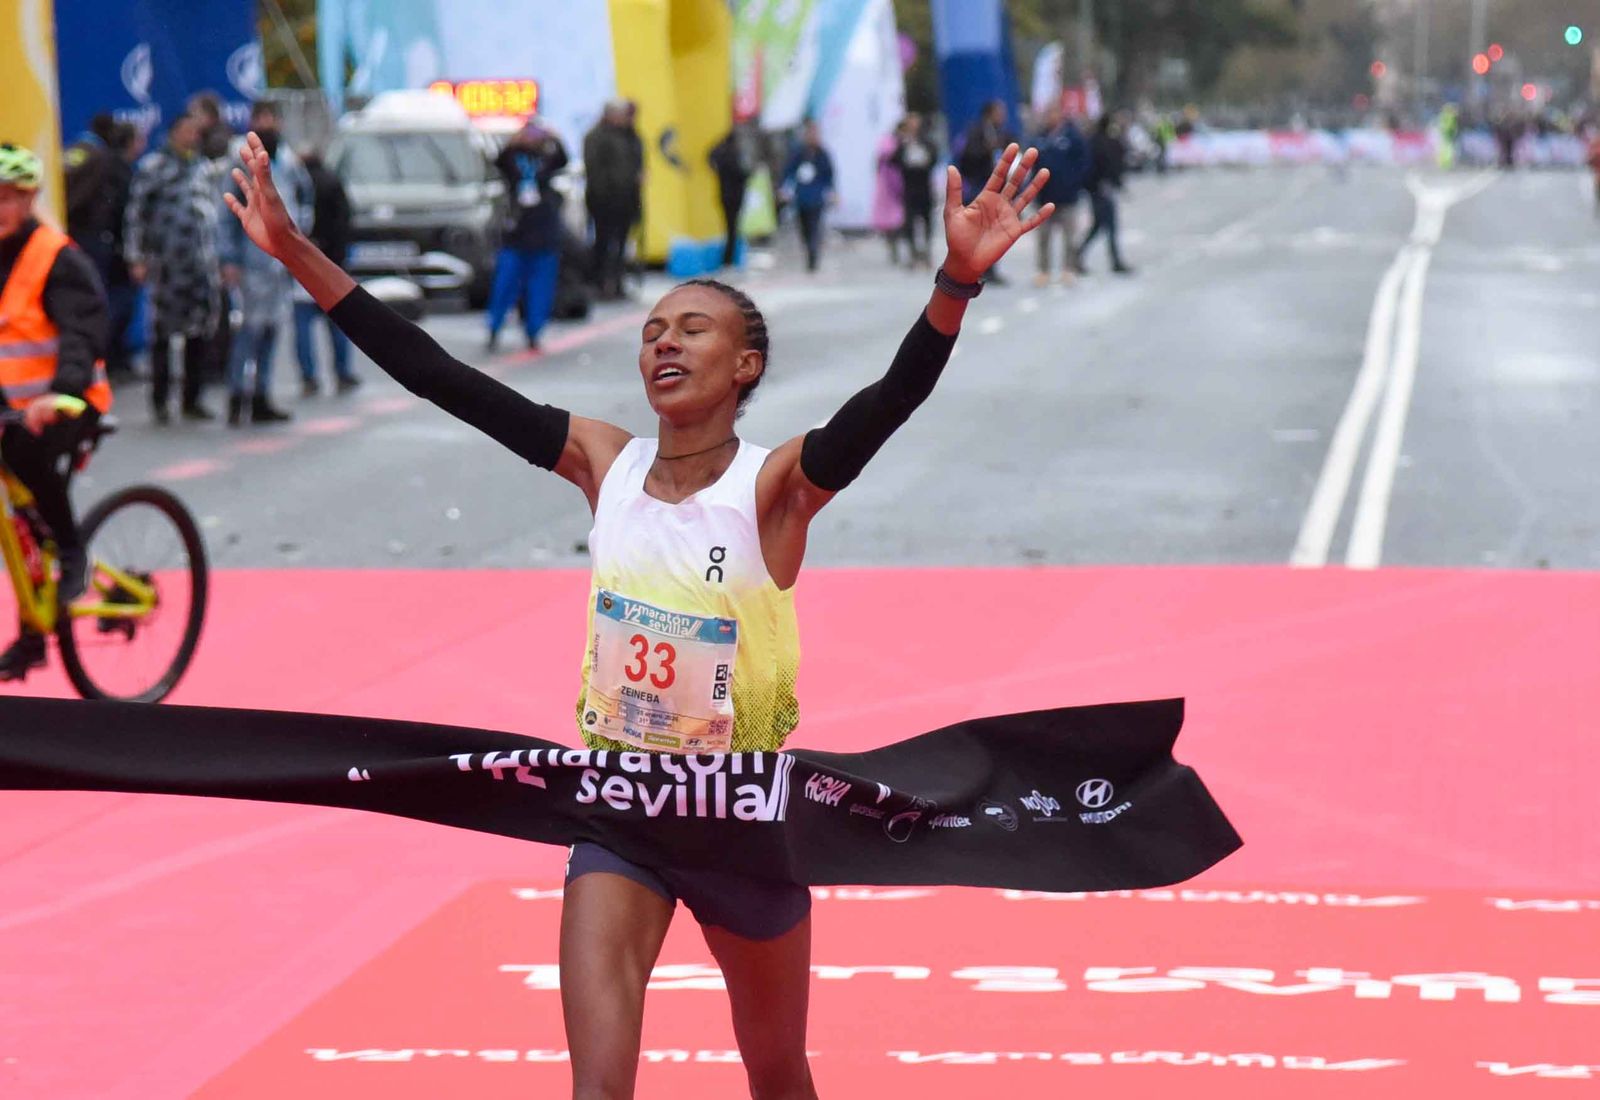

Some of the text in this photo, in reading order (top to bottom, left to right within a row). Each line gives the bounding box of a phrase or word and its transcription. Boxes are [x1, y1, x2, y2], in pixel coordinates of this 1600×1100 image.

[649, 618, 690, 636] sevilla
[624, 634, 677, 690] 33
[621, 686, 660, 703] ZEINEBA
[575, 768, 772, 821] sevilla
[805, 772, 852, 807] HOKA
